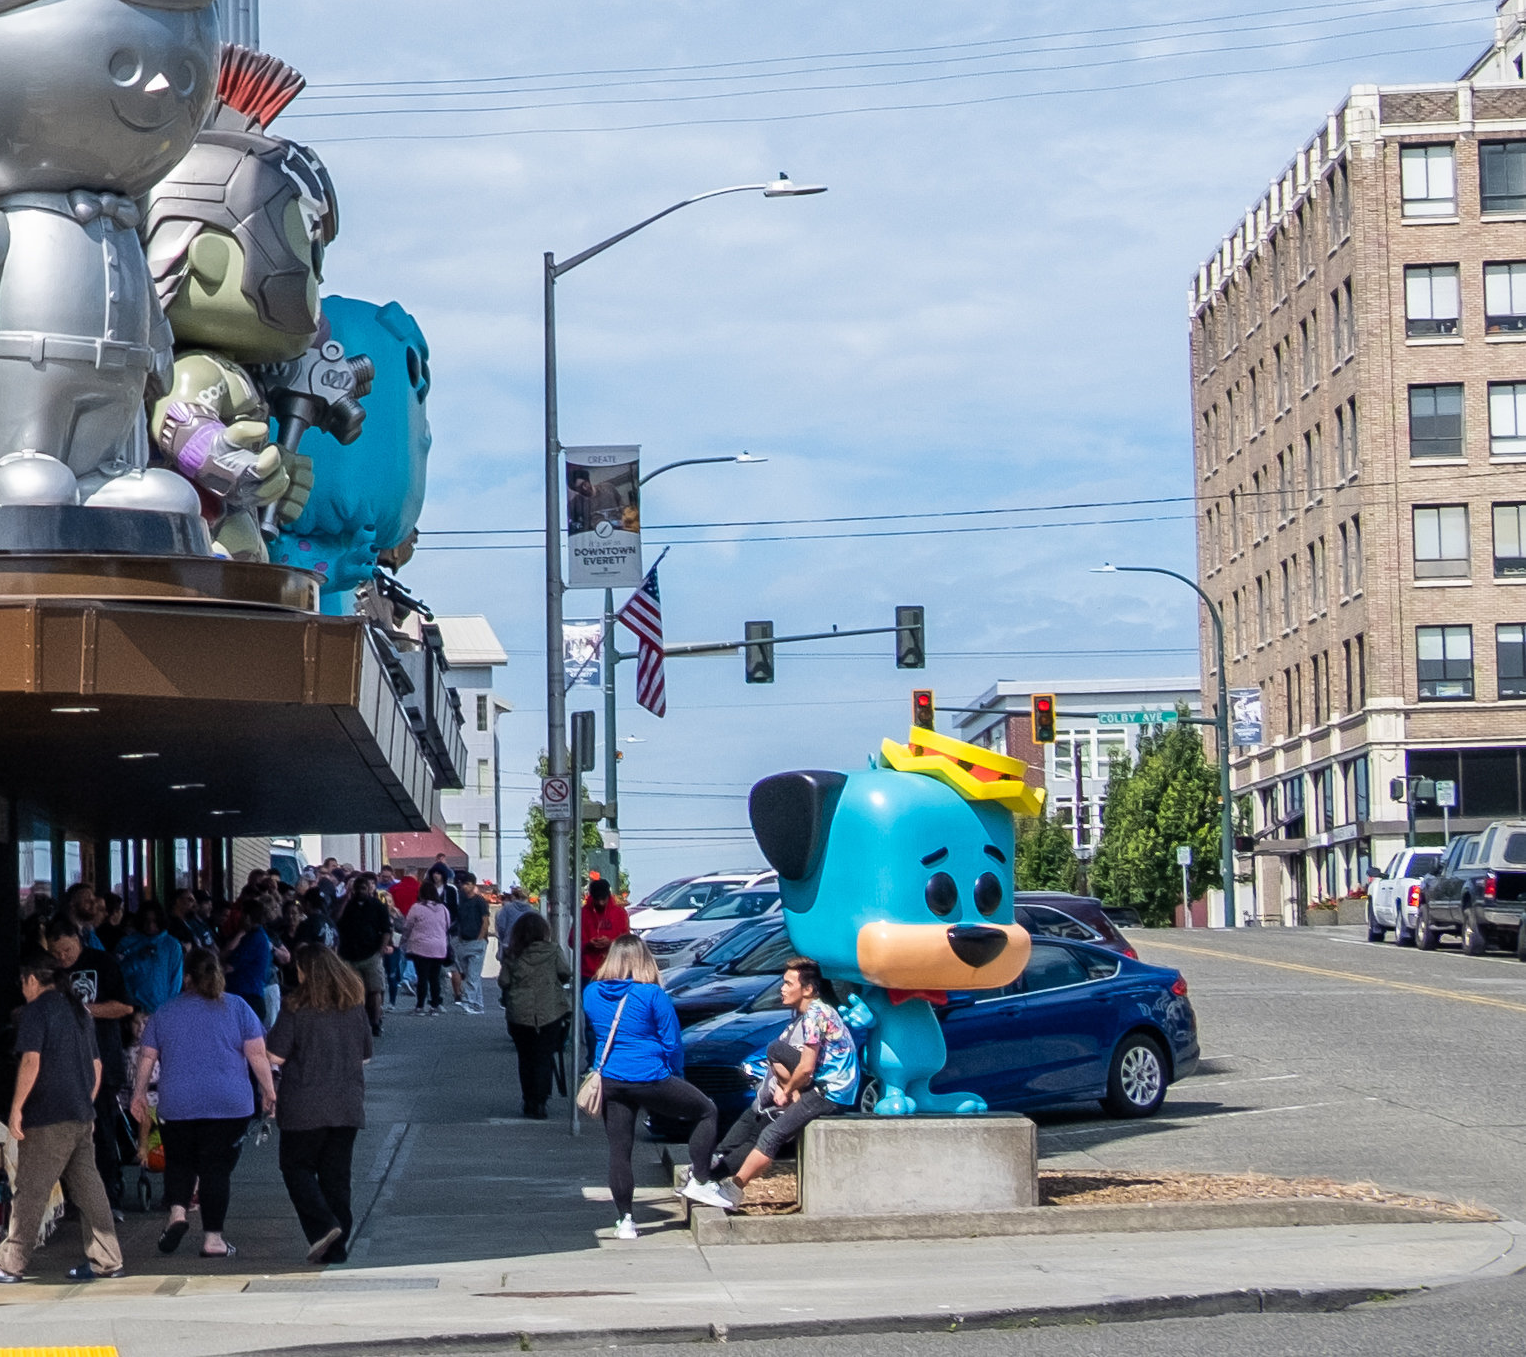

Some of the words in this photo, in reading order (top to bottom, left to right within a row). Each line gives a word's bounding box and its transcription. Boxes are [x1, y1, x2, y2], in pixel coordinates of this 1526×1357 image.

[588, 455, 617, 464] CREATE
[574, 547, 636, 556] DOWNTOWN
[583, 556, 627, 565] EVERETT
[1100, 714, 1136, 724] COLBY
[1142, 712, 1163, 722] AVE
